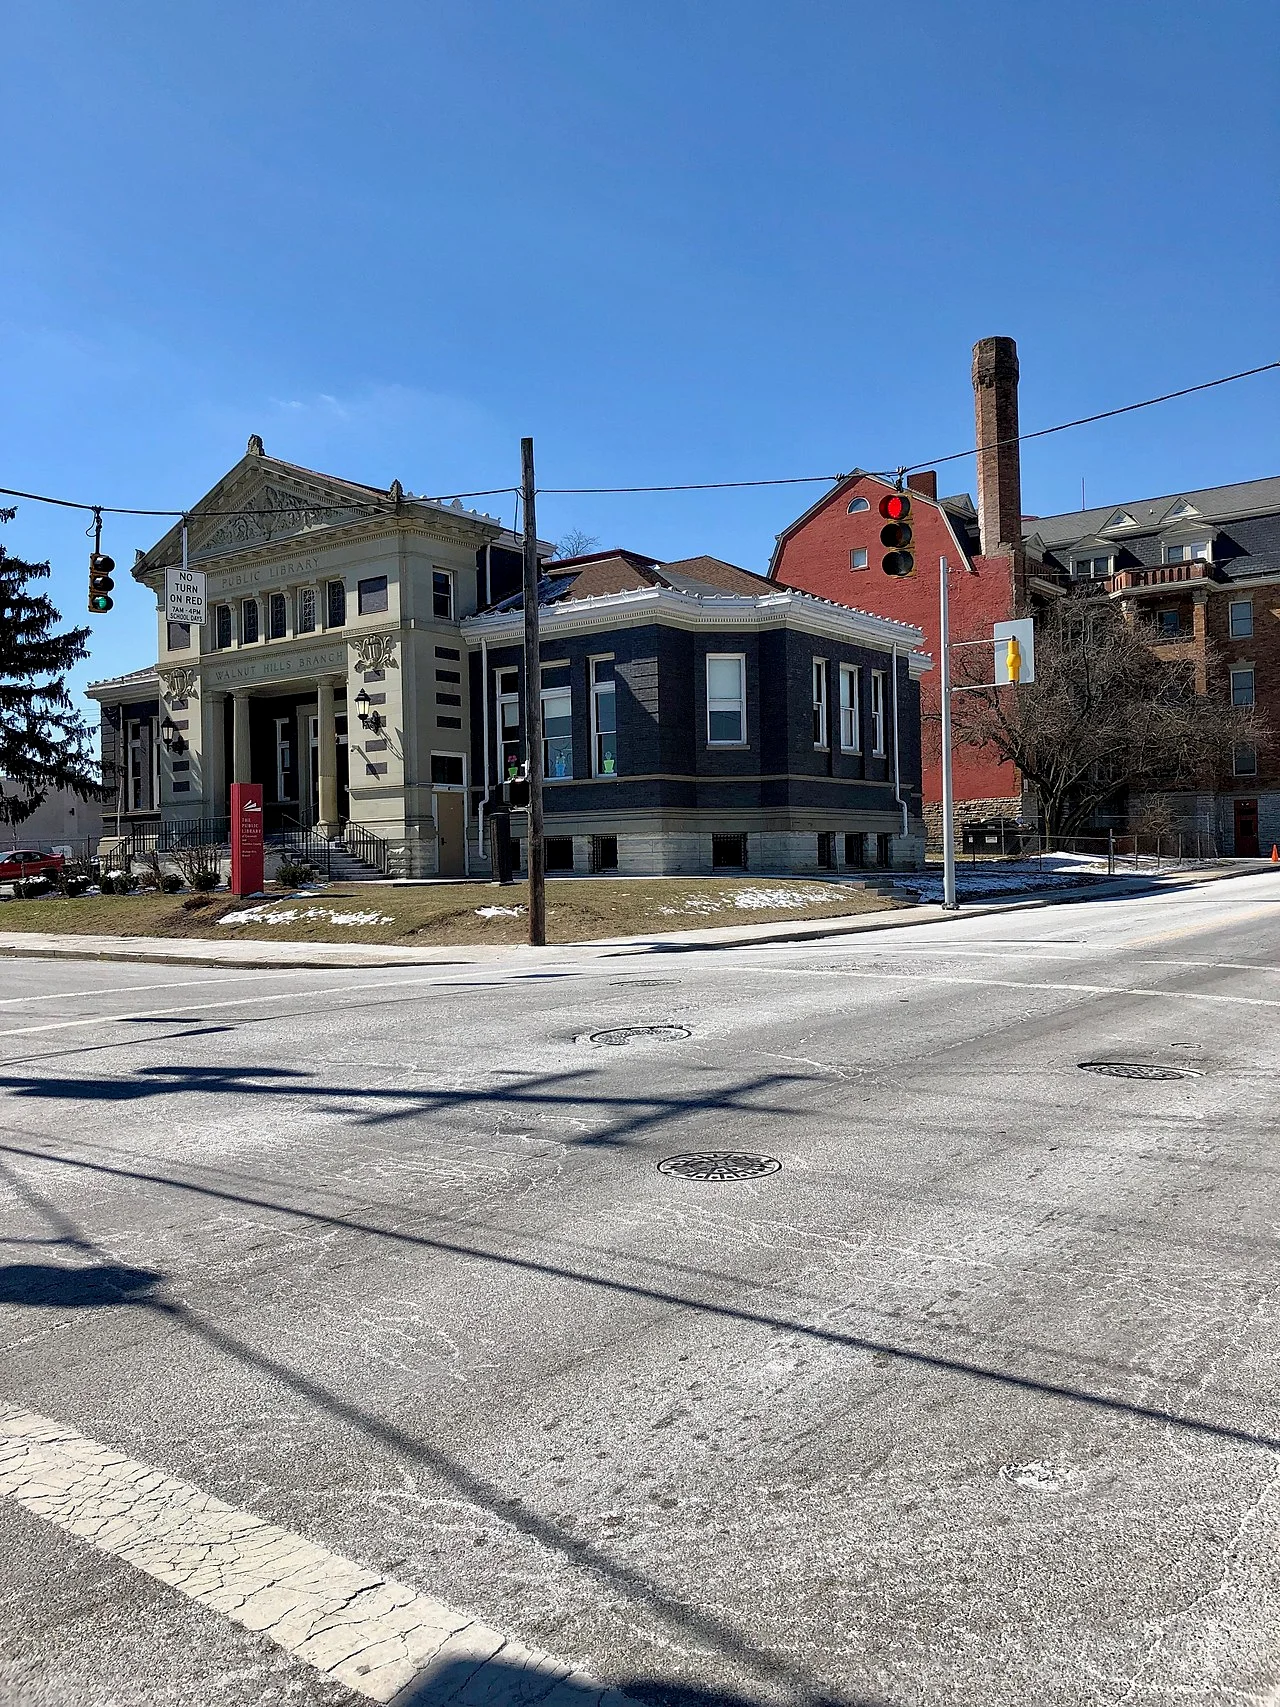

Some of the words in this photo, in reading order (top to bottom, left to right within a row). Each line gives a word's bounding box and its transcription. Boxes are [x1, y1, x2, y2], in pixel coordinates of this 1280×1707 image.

[180, 572, 193, 581] NO
[222, 571, 260, 588] PUBLIC
[270, 558, 320, 577] LIBRARY
[175, 583, 198, 593] TURN
[170, 594, 182, 603] ON
[186, 596, 203, 605] RED
[170, 613, 189, 621] SCHOOL
[215, 665, 256, 681] WALNUT
[263, 660, 291, 673] HILLS
[299, 651, 344, 667] BRANCH
